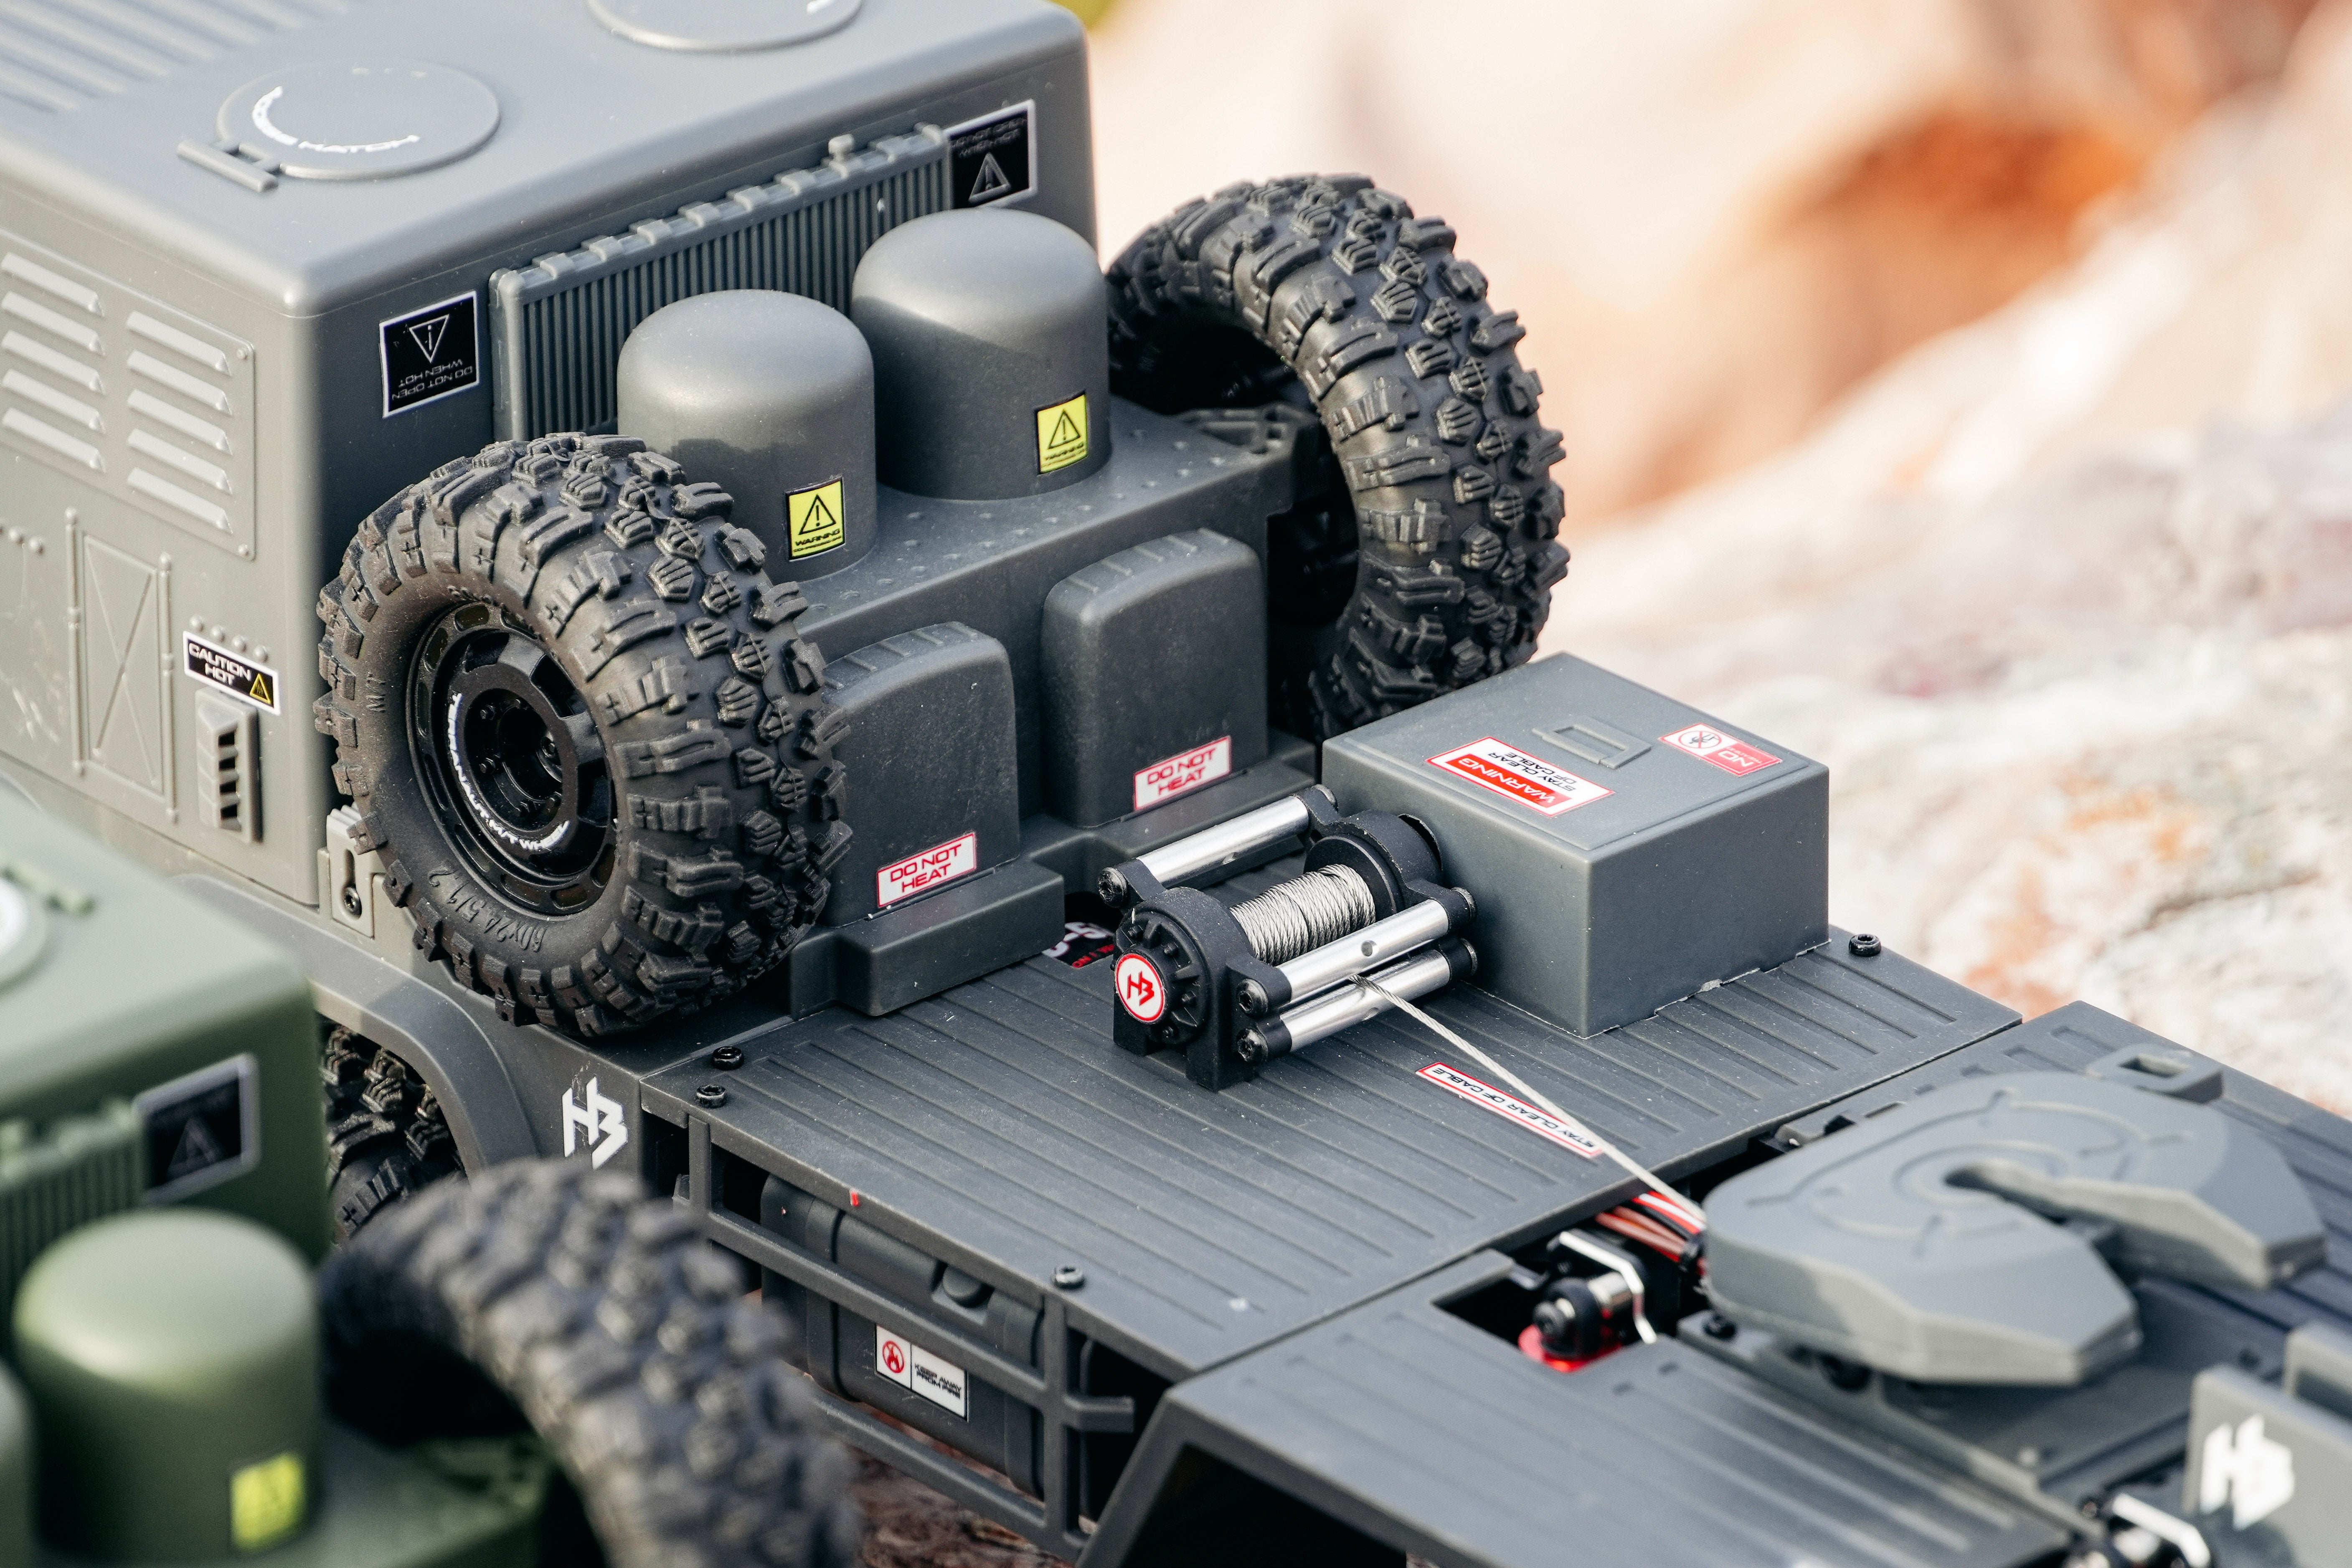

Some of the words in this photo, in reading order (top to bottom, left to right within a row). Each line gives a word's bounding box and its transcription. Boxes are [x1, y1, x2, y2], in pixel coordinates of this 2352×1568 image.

[425, 358, 463, 377] WHEN
[454, 365, 474, 378] DO
[398, 371, 423, 388] HOT
[427, 373, 453, 388] NOT
[392, 383, 425, 400] OPEN
[795, 528, 840, 546] WARNING
[189, 642, 251, 681] CAUTION
[205, 663, 235, 685] HOT
[1147, 766, 1173, 785] DO
[1178, 747, 1215, 773] NOT
[1488, 752, 1538, 775] CLEAR
[1505, 752, 1555, 774] CABLE
[1718, 750, 1754, 767] NO
[1158, 766, 1205, 796] HEAT
[1457, 757, 1555, 803] WARNING
[1537, 775, 1576, 792] STAY
[1553, 776, 1576, 784] OF
[519, 820, 570, 850] WHEEL
[891, 862, 917, 882] DO
[922, 844, 962, 870] NOT
[902, 863, 951, 893] HEAT
[1432, 1068, 1483, 1093] CABLE
[1482, 1093, 1505, 1103] OF
[1507, 1104, 1559, 1129] CLEAR
